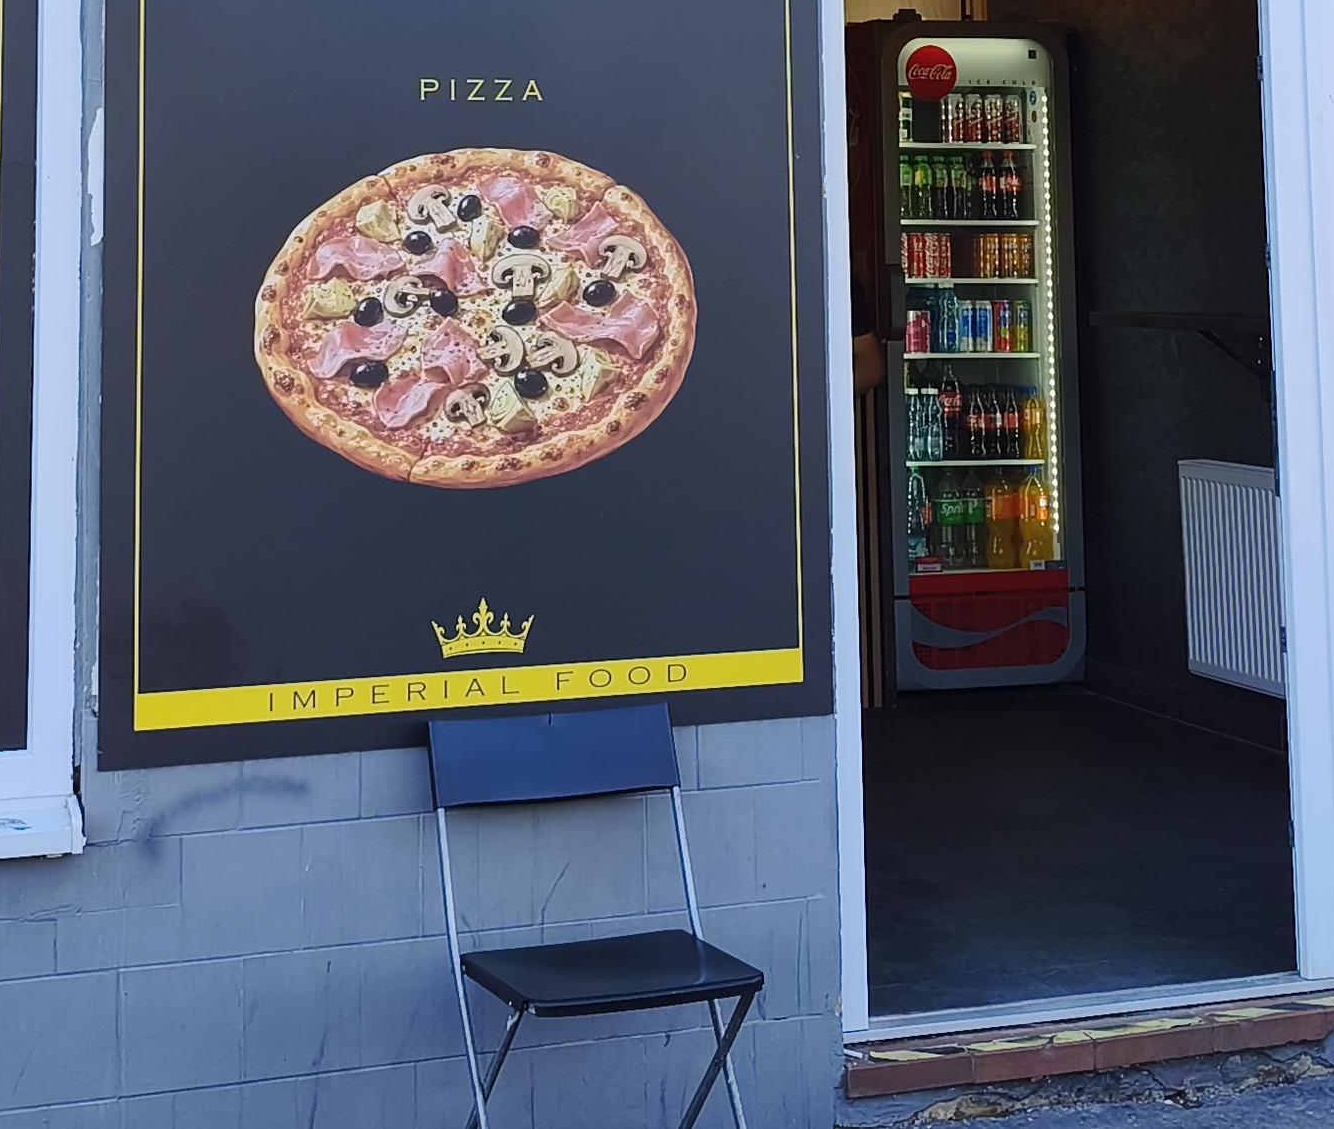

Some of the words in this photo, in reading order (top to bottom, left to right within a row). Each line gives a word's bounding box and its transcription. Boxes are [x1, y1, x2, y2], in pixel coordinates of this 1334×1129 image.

[419, 78, 544, 102] PIZZA
[268, 675, 521, 713] IMPERIAL
[555, 662, 689, 691] FOOD
